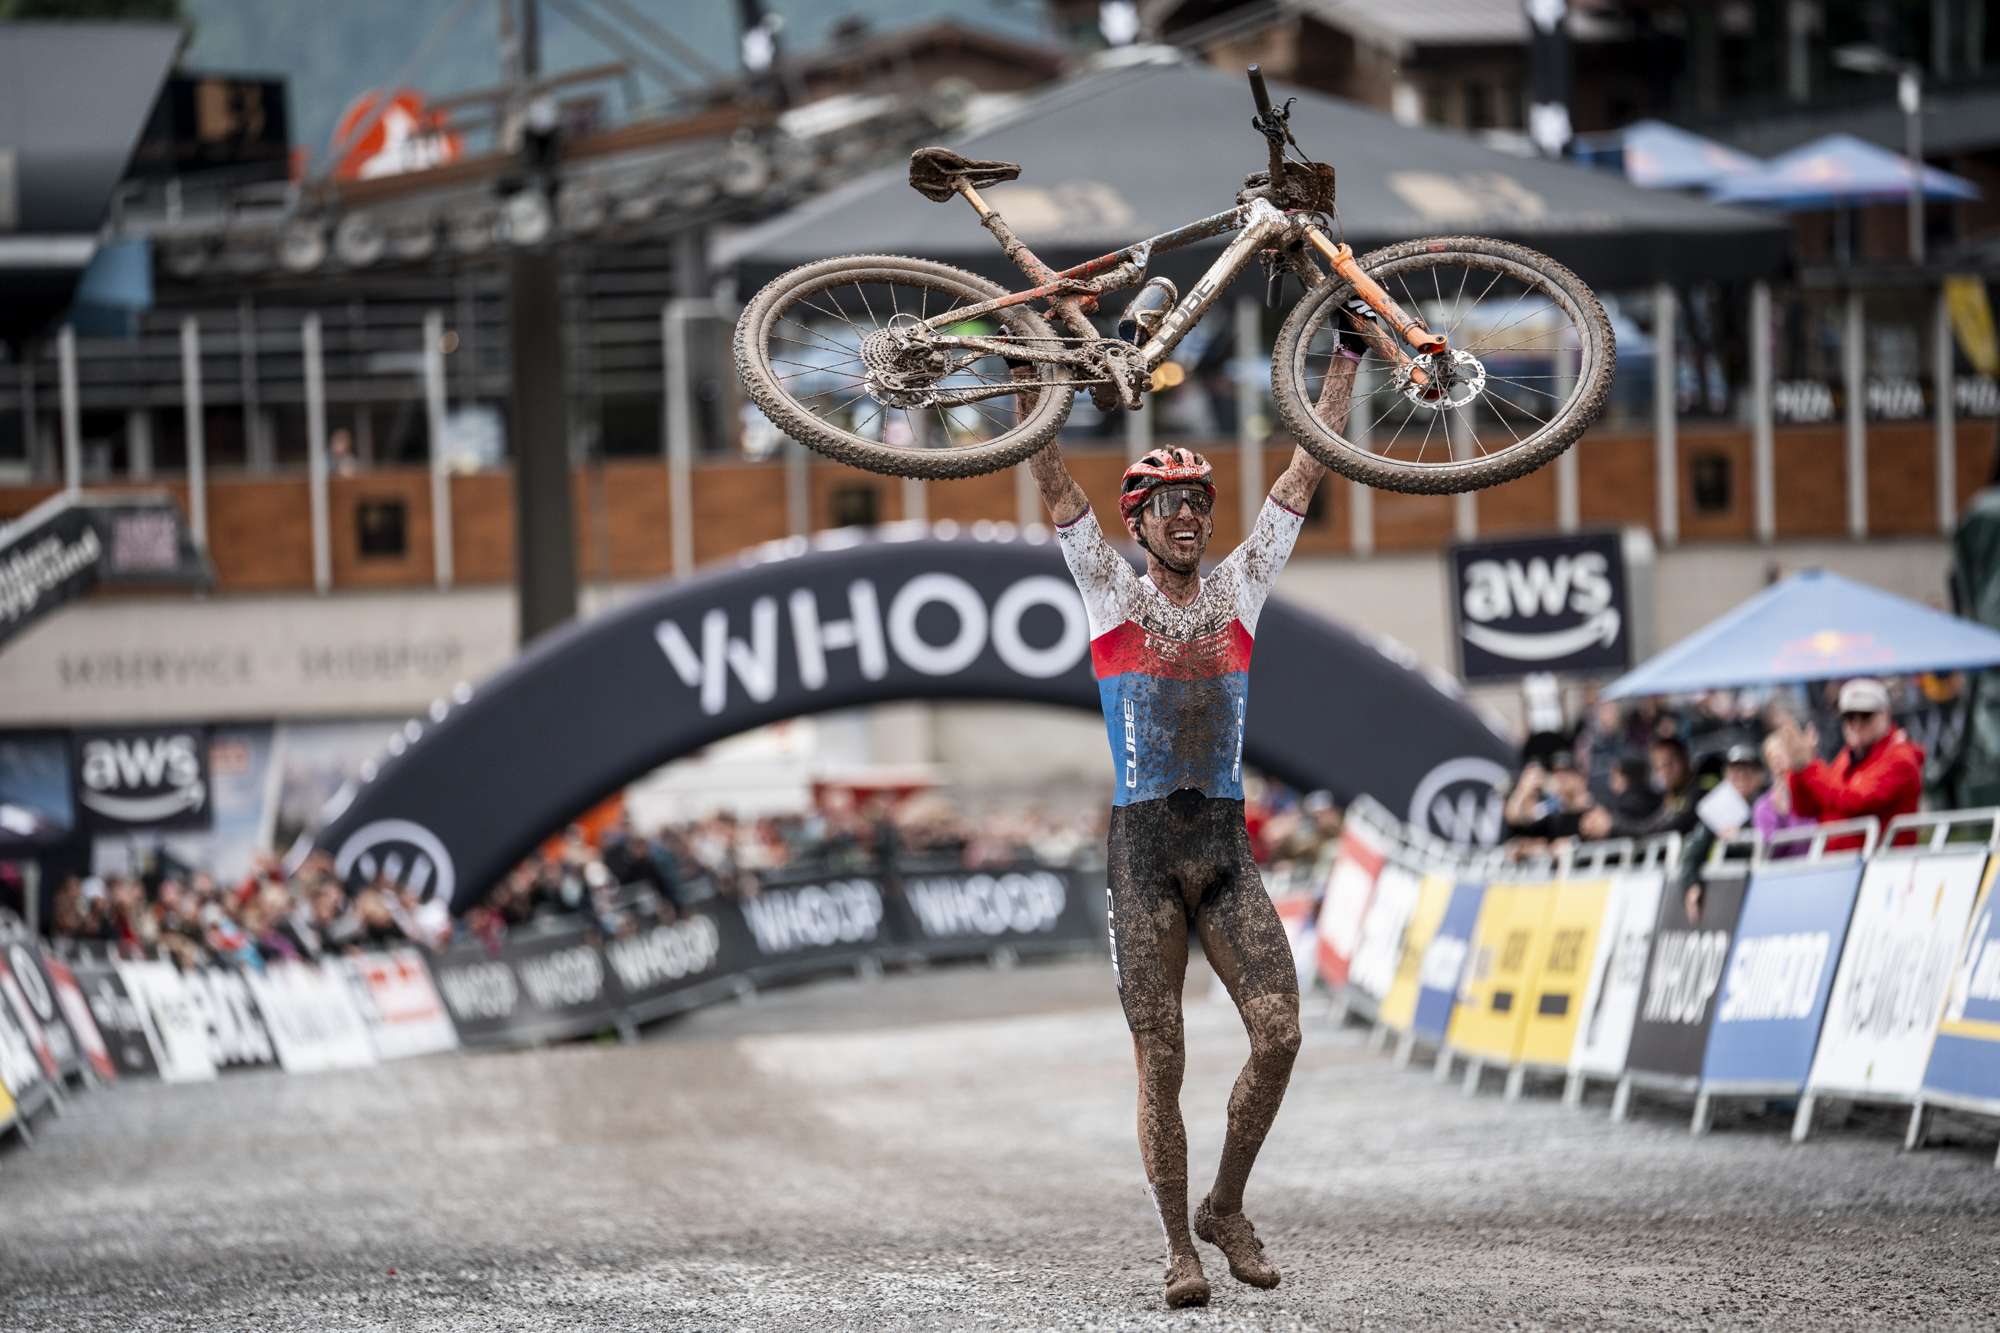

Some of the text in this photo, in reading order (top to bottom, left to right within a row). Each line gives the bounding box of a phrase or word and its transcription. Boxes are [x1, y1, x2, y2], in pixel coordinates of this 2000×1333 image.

[1463, 552, 1612, 622] aws
[654, 572, 1091, 716] WHOO
[82, 735, 199, 790] aws
[1123, 698, 1137, 788] CUBE
[740, 878, 884, 953] WHOOP
[908, 872, 1066, 936] WHOOP
[1643, 930, 1728, 1024] WHOOP
